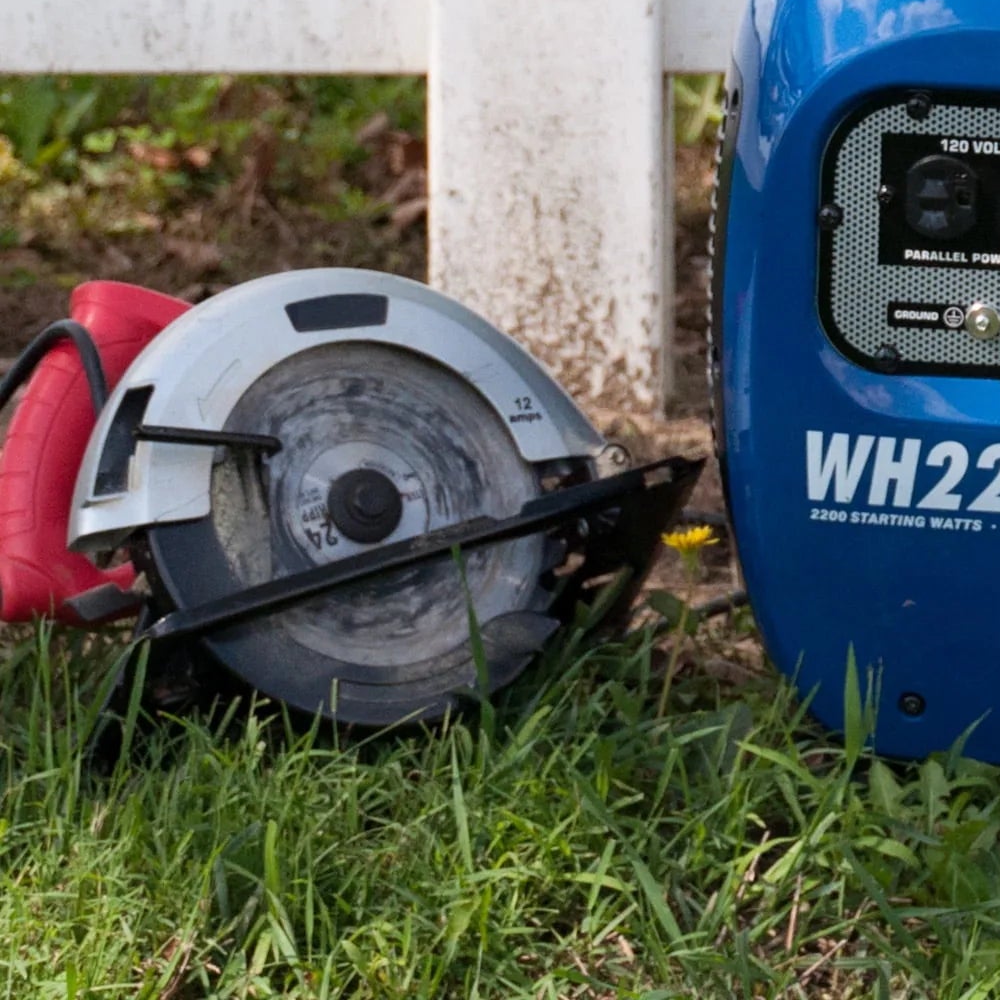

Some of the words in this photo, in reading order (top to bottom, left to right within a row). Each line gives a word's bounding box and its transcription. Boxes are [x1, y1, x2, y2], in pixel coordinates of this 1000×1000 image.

[940, 139, 969, 153] 120
[904, 249, 968, 263] PARALLEL
[894, 309, 939, 320] GROUND
[514, 396, 532, 410] 12
[810, 508, 847, 523] 2200
[849, 511, 926, 529] STARTING
[929, 516, 983, 533] WATTS
